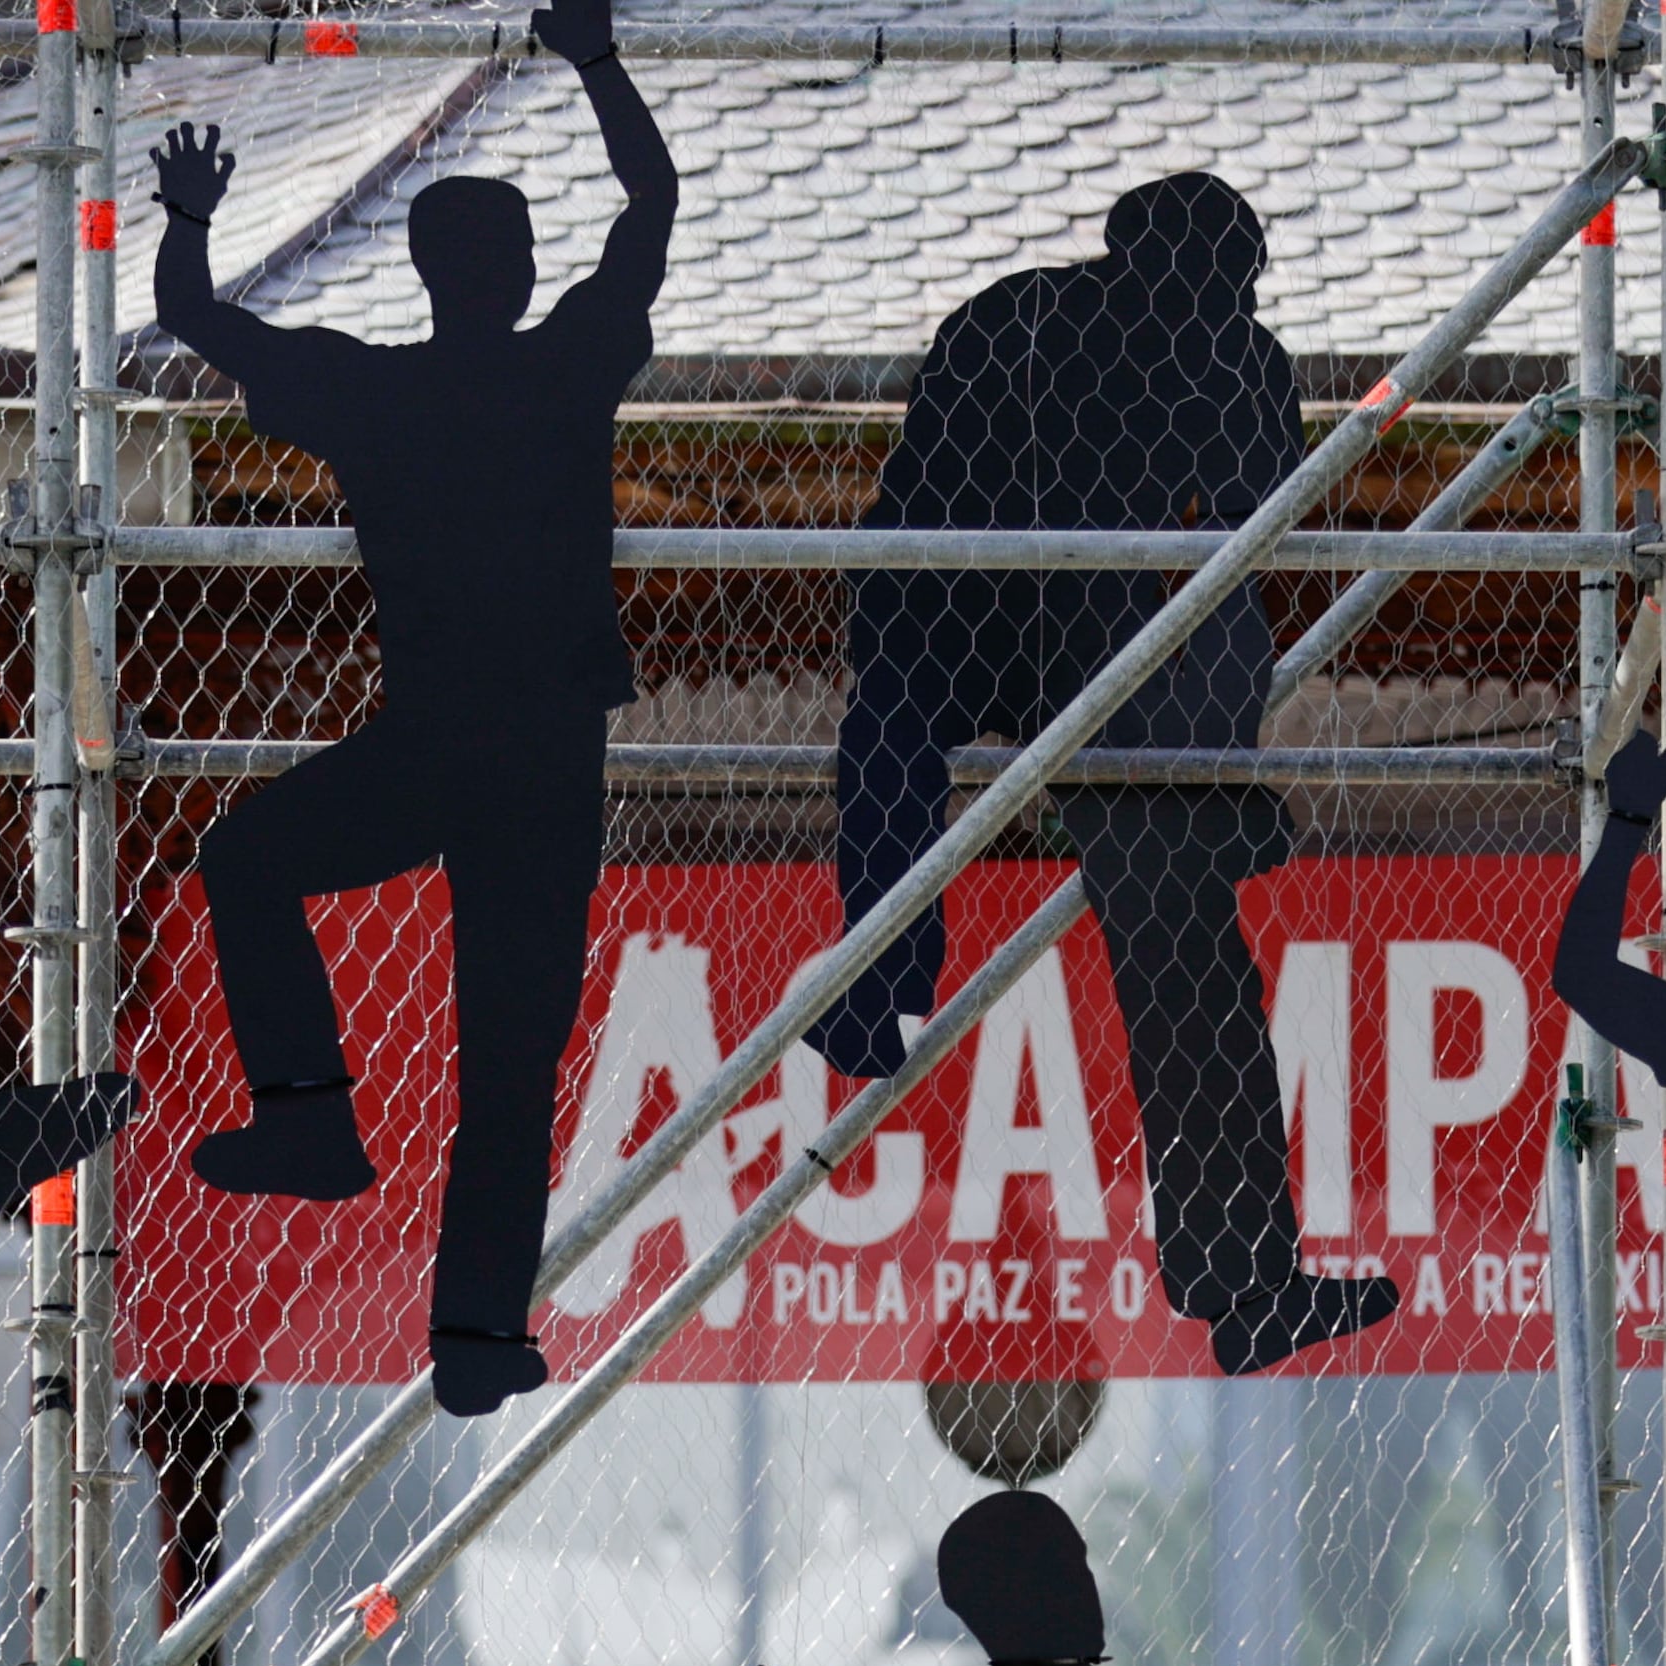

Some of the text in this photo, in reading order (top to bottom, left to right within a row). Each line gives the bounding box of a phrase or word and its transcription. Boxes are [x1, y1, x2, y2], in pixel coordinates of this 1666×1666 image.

[773, 1260, 909, 1325] POLA
[933, 1258, 1033, 1323] PAZ
[1057, 1258, 1089, 1321] E
[1111, 1257, 1147, 1321] O
[1412, 1254, 1448, 1317] A
